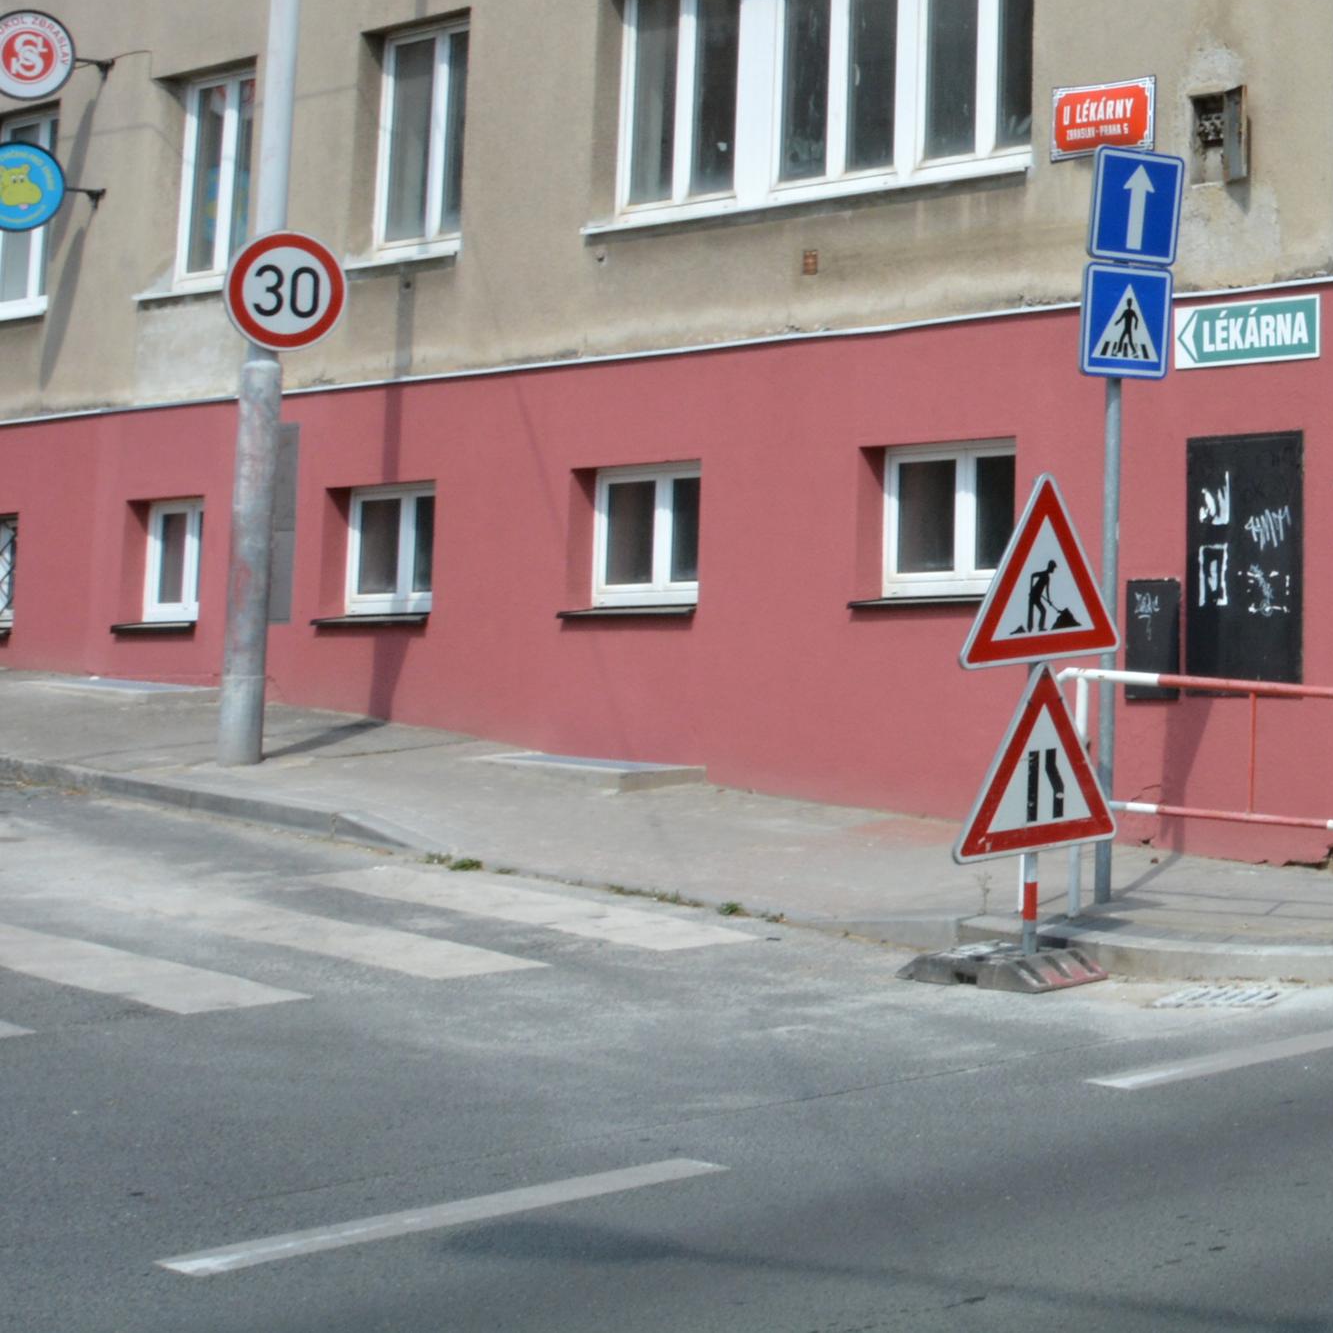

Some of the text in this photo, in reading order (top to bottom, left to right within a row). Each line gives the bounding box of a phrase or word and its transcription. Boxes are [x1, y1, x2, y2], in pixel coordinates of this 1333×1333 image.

[31, 15, 70, 67] ZBRASLAV
[1063, 96, 1134, 126] U LÉKÁRNY
[253, 264, 320, 318] 30
[1202, 306, 1309, 353] LÉKÁRNA
